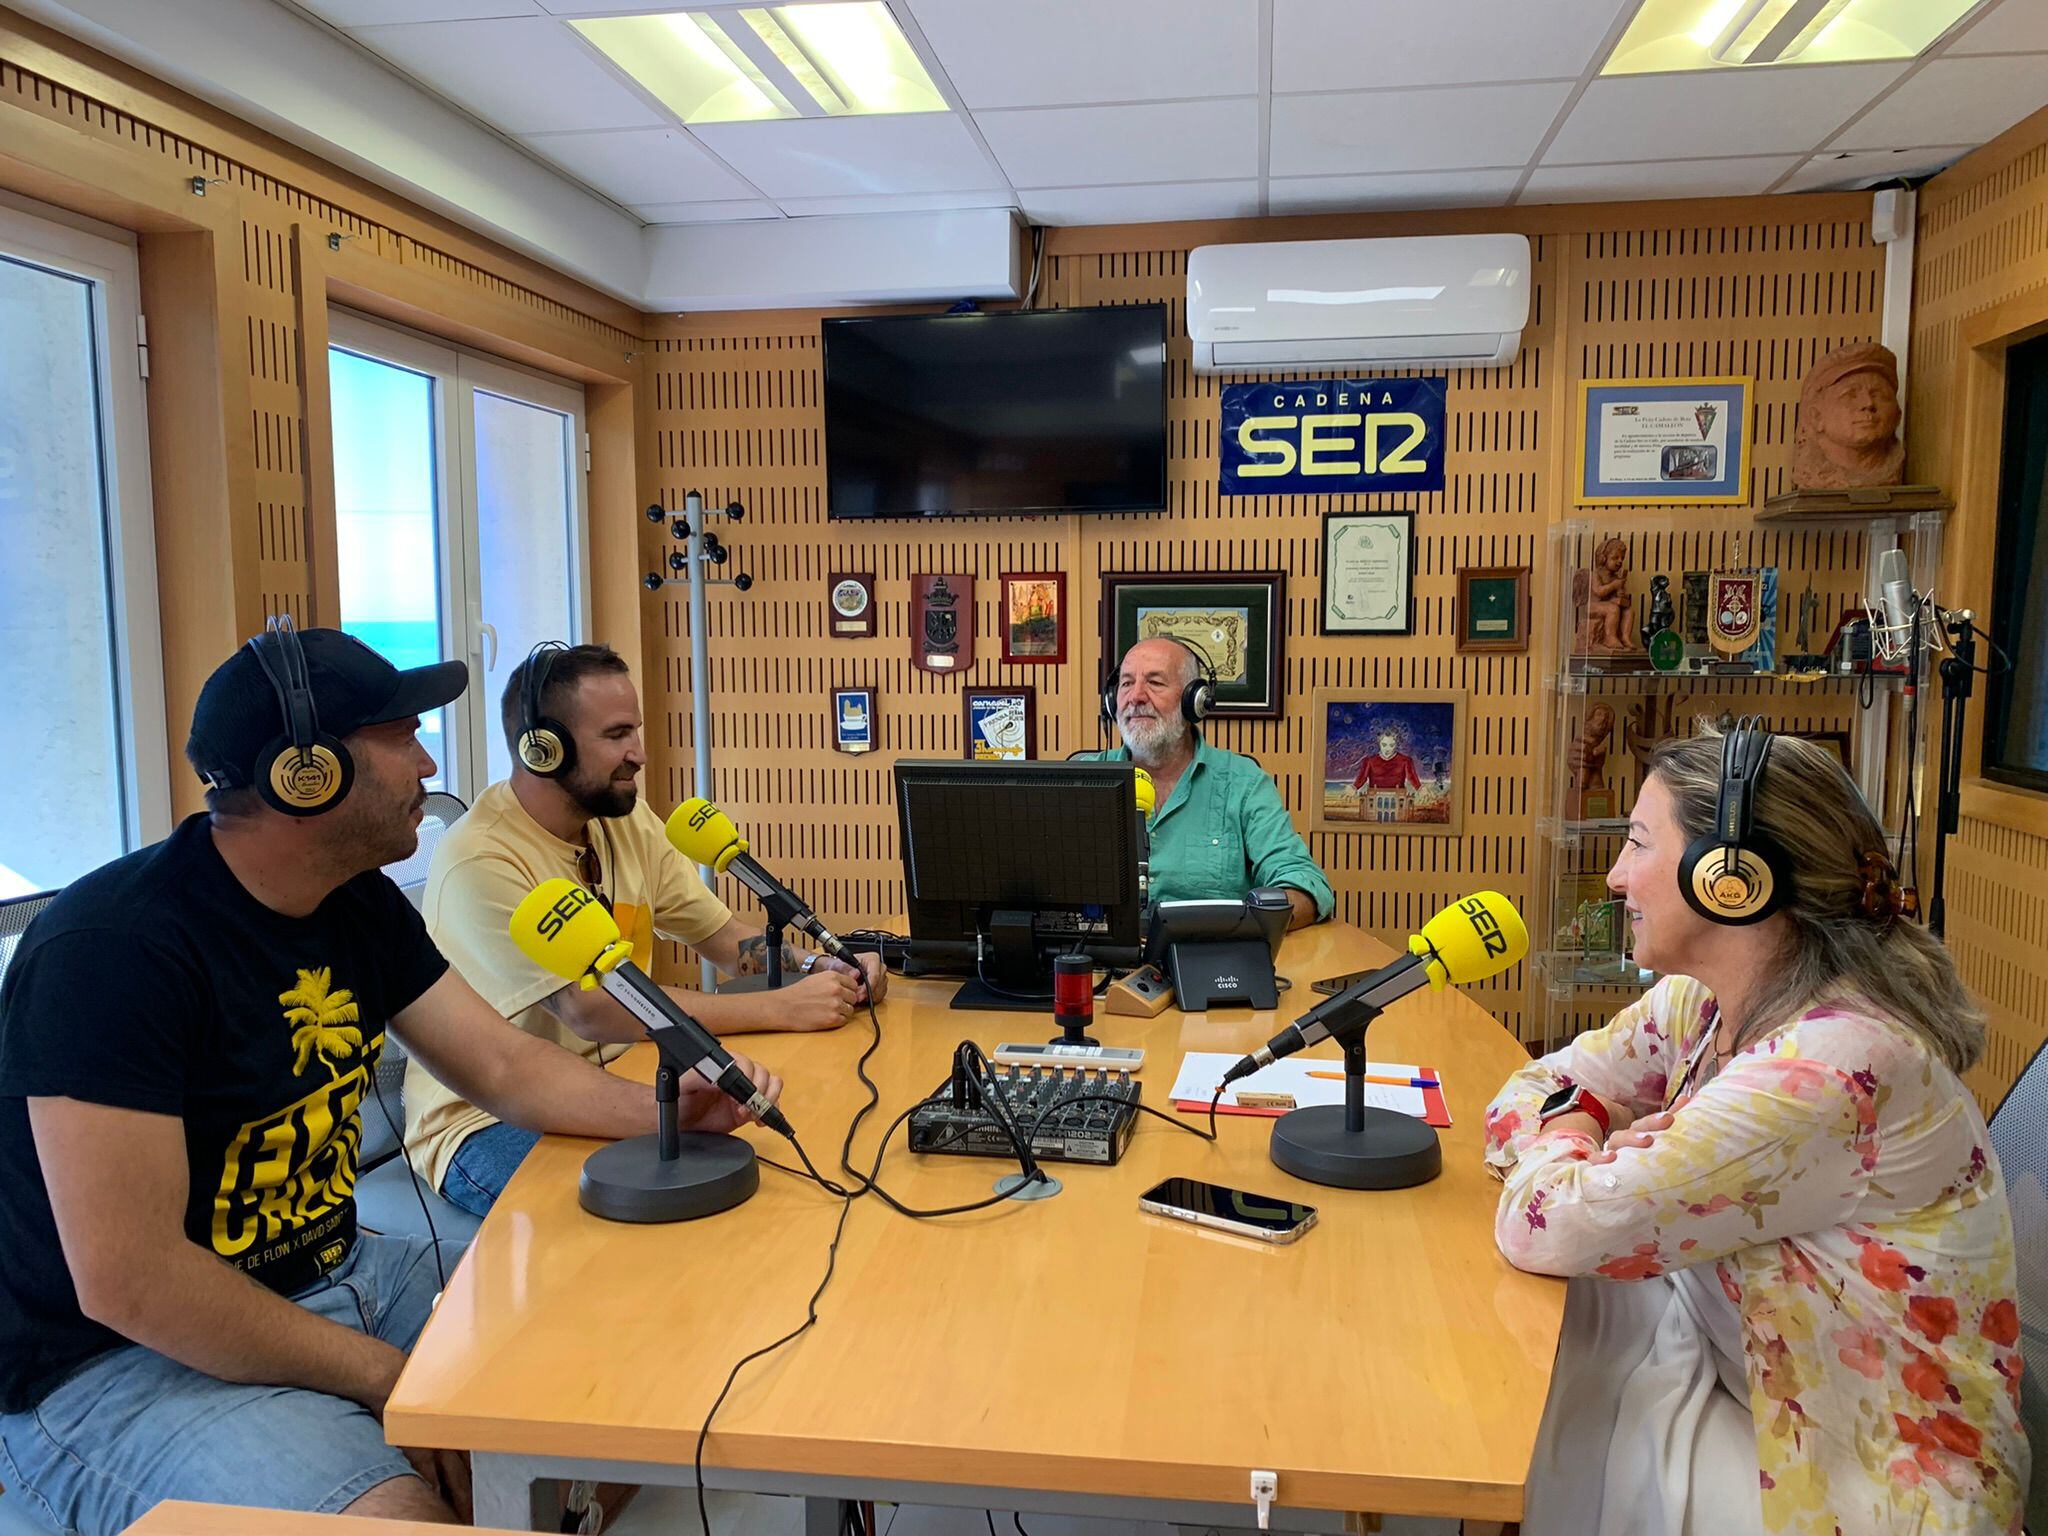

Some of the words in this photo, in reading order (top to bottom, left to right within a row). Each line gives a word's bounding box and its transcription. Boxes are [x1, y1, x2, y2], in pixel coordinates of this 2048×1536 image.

[1274, 392, 1393, 408] CADENA
[1237, 412, 1427, 477] SER
[537, 887, 594, 942] SER
[1459, 898, 1508, 960] SER
[247, 1253, 260, 1270] DE
[264, 1242, 290, 1263] FLOW
[301, 1224, 325, 1246] DAVID
